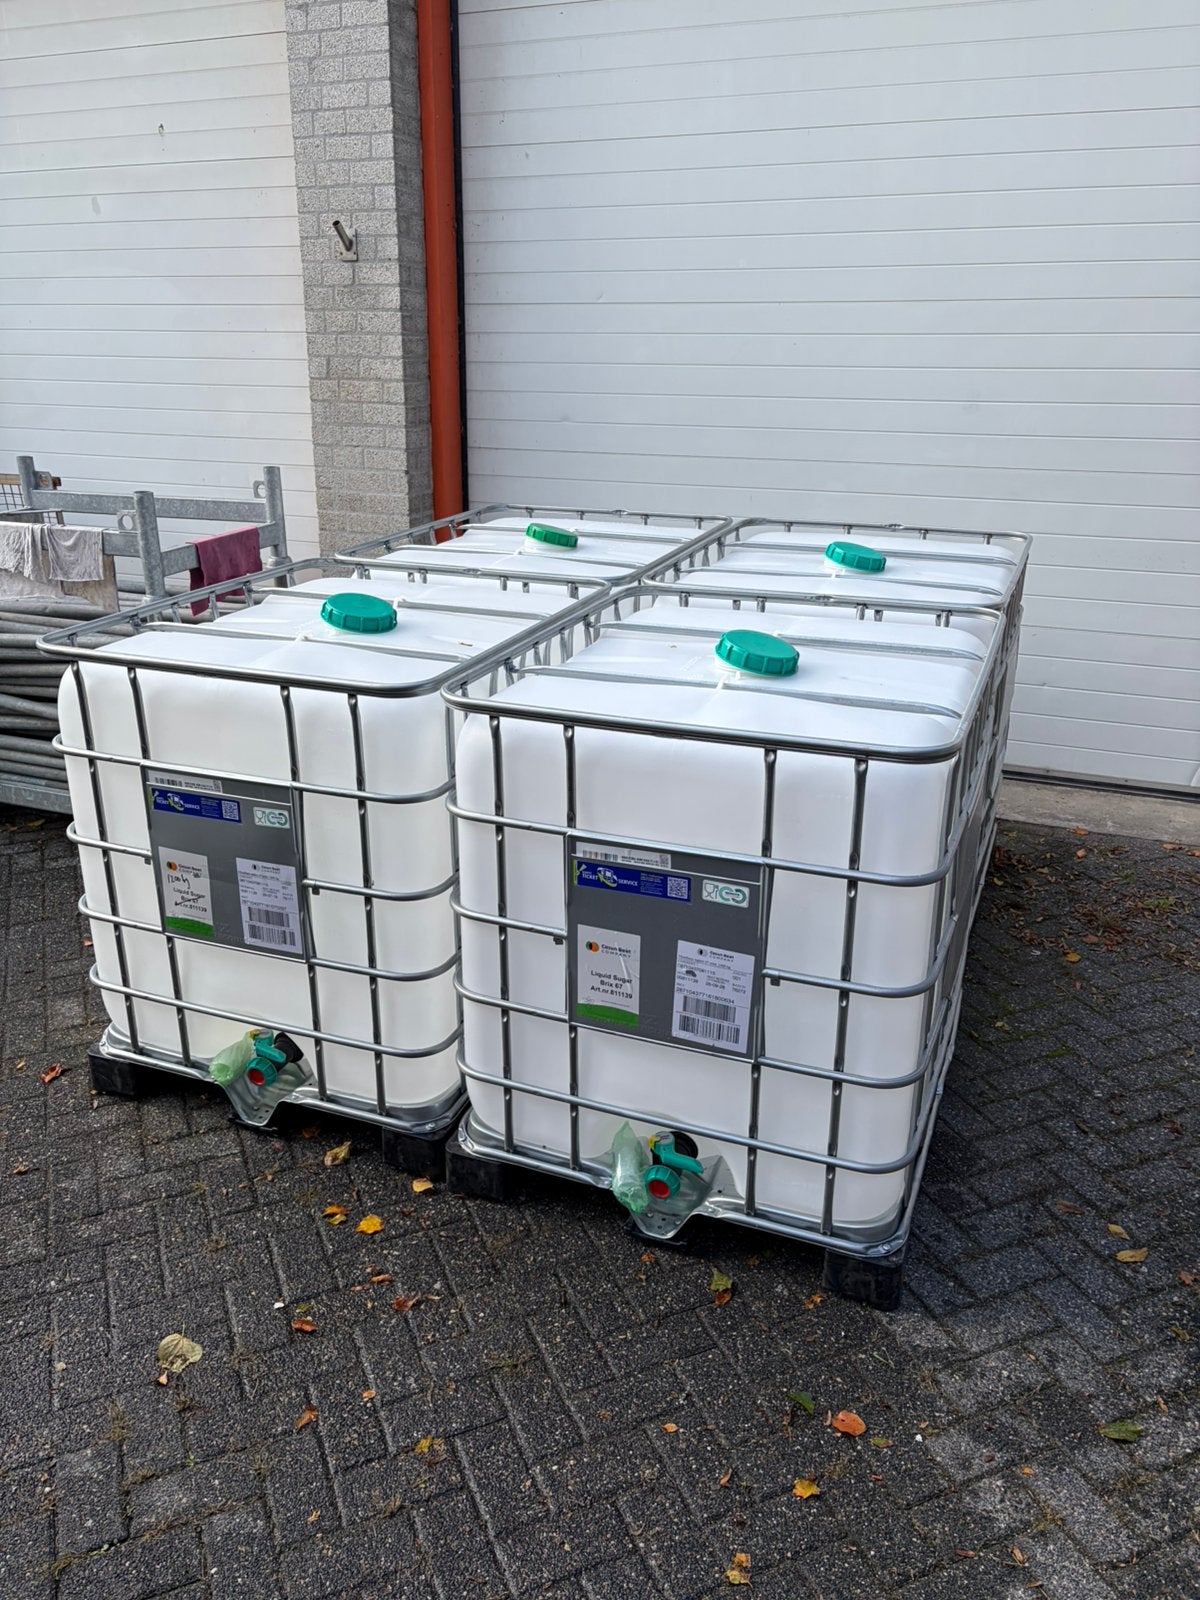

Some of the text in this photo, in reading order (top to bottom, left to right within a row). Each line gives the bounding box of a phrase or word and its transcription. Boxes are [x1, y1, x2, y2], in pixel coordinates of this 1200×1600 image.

[582, 873, 639, 887] TICKET SERVICE
[173, 887, 189, 896] Liquid
[601, 943, 618, 952] Cosun
[601, 950, 631, 958] COMPANY
[590, 970, 633, 984] Liquid Sugar
[600, 980, 613, 988] Brix
[590, 985, 633, 999] Art.nr.811139
